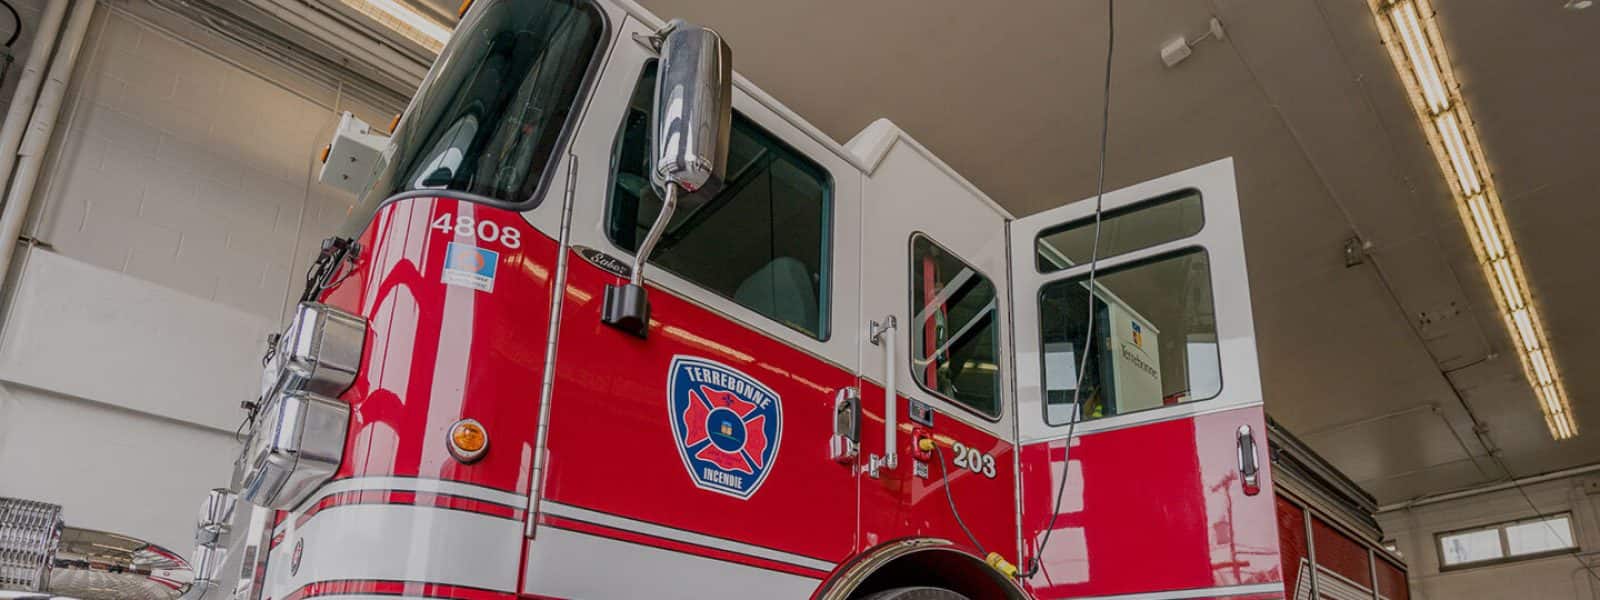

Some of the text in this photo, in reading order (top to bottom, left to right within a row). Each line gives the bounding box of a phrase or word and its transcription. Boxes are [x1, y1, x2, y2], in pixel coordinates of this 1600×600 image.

[432, 213, 521, 248] 4808
[684, 367, 772, 410] TERREBONNE
[704, 467, 743, 489] INCENDIE
[953, 442, 997, 479] 203
